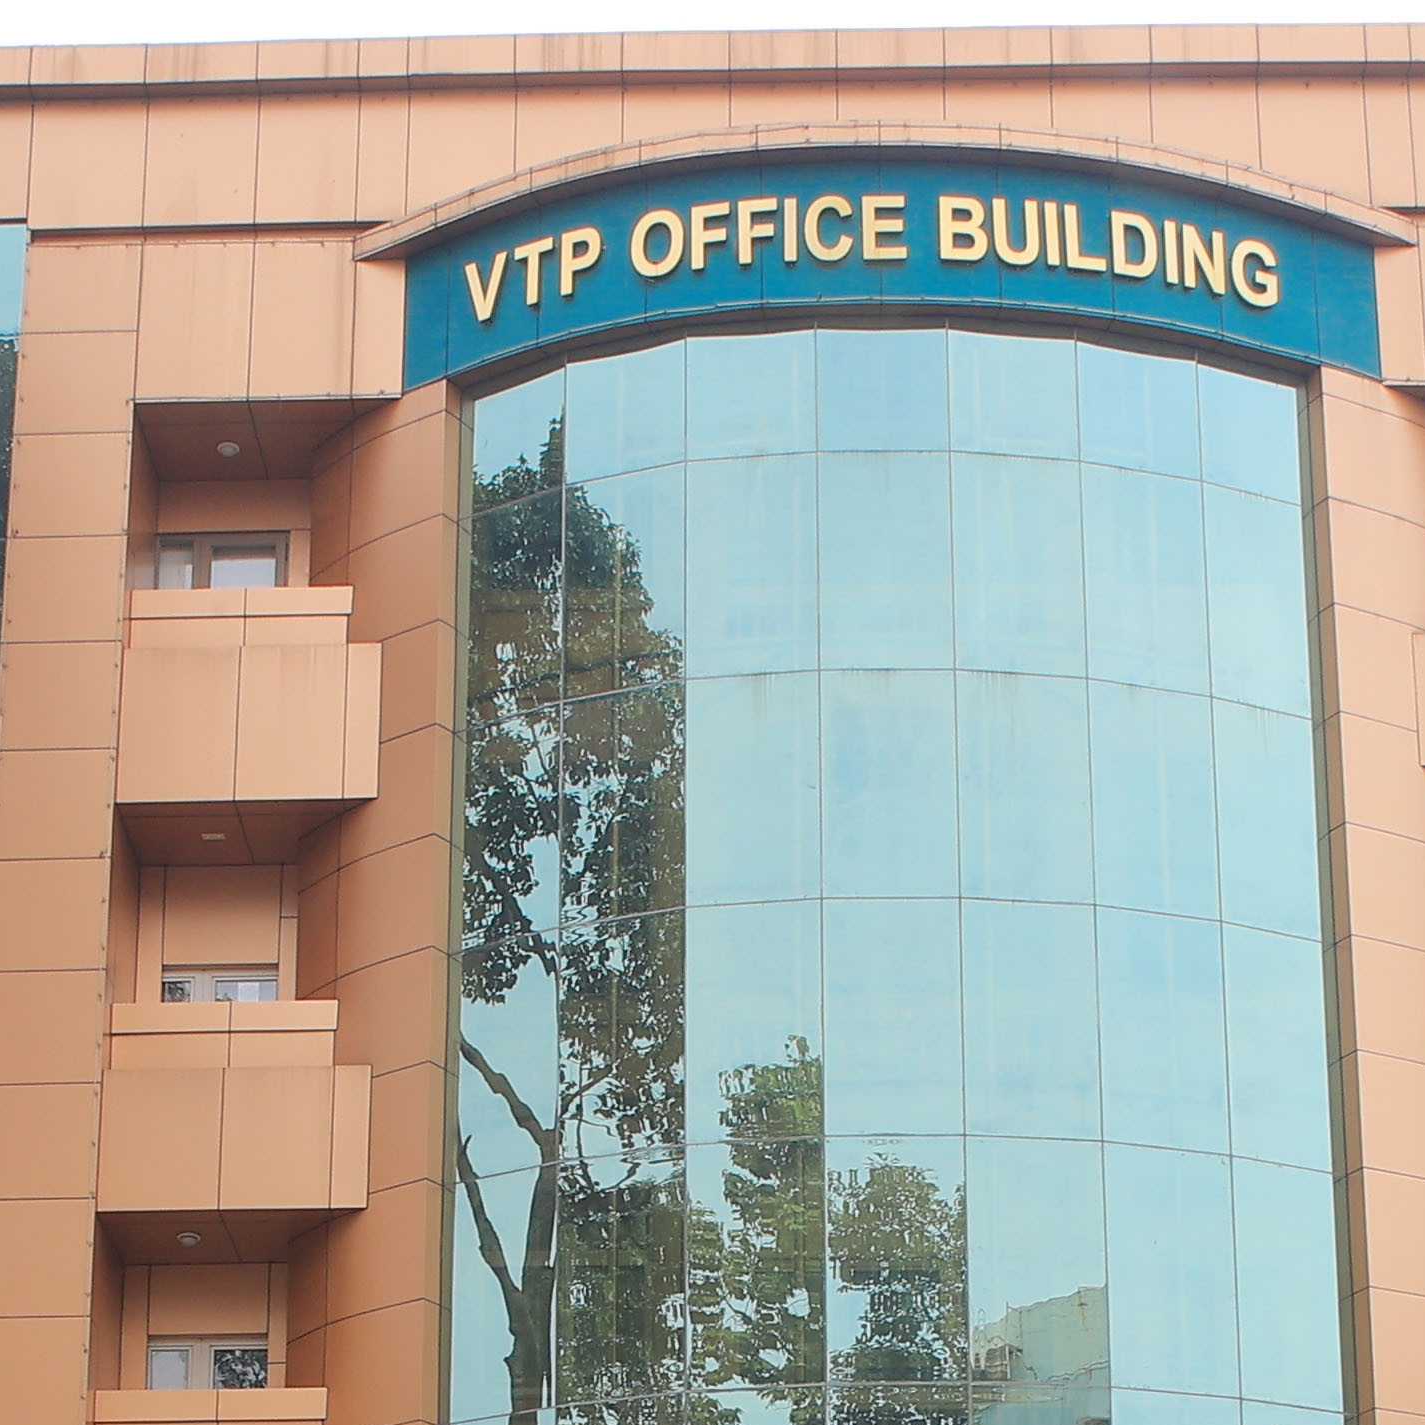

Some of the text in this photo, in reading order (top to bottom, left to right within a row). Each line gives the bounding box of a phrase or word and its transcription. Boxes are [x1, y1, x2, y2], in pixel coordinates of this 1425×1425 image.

[463, 194, 1280, 322] VTP OFFICE BUILDING
